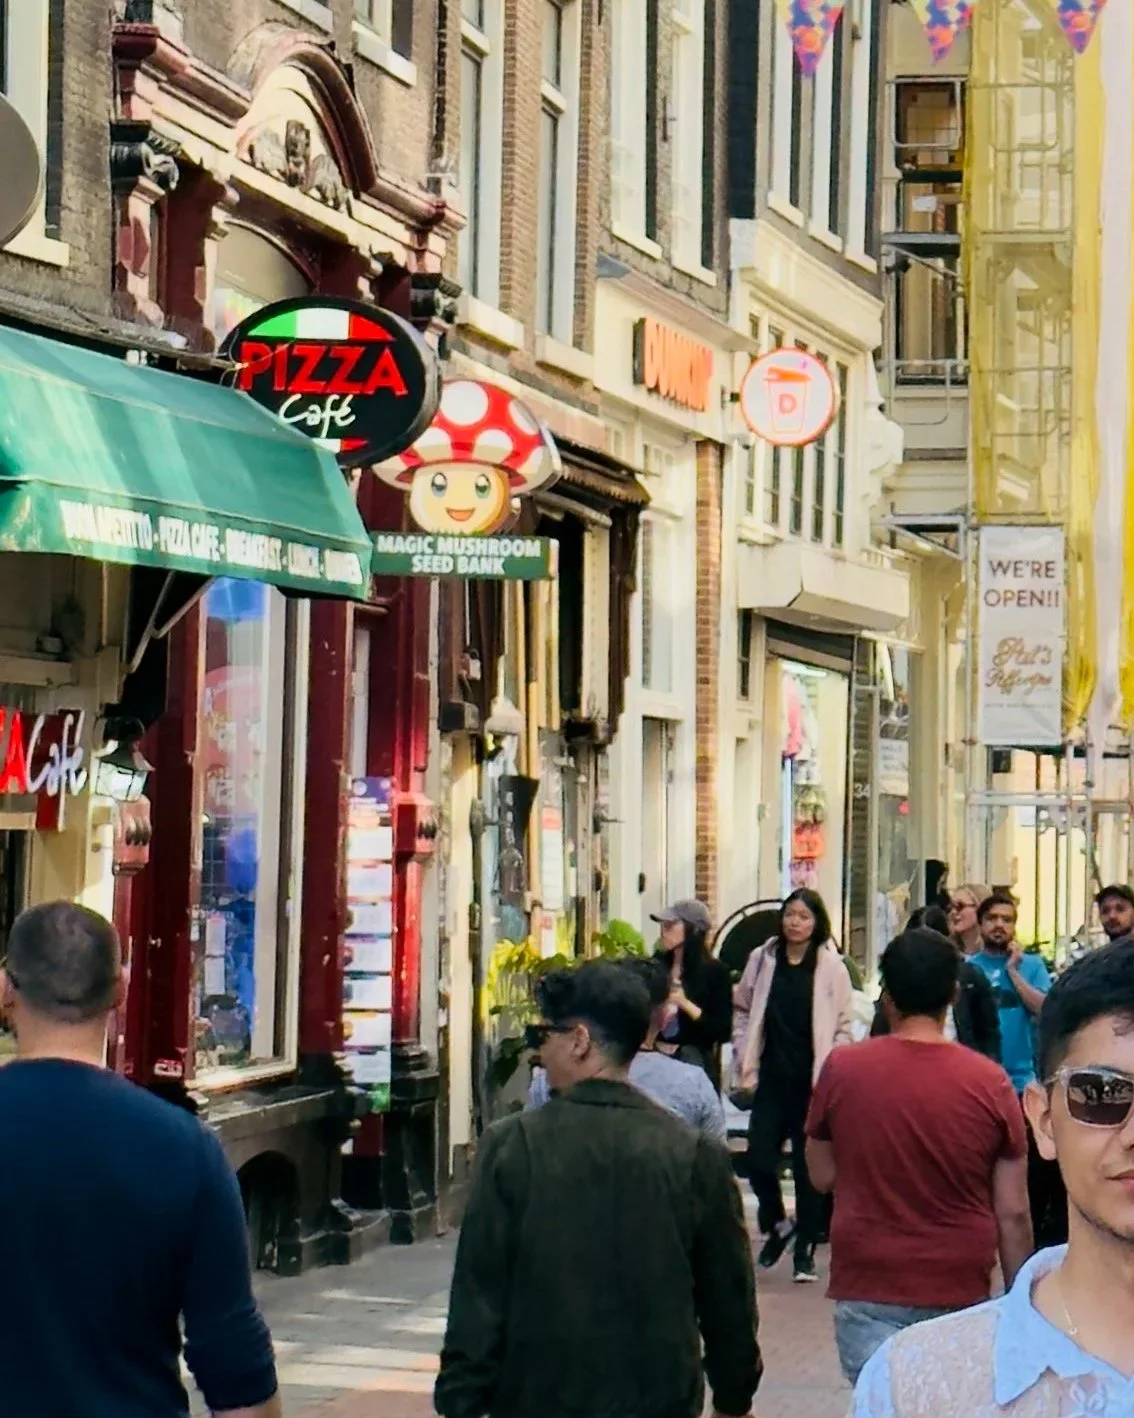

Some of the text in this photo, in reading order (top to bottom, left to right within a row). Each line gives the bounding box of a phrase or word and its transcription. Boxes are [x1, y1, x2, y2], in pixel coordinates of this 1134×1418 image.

[238, 341, 408, 396] PIZZA
[280, 393, 356, 439] Café
[377, 534, 541, 558] MAGIC MUSHROOM
[411, 555, 506, 575] SEED BANK
[988, 560, 1056, 579] WE'RE
[983, 588, 1060, 608] OPEN!!
